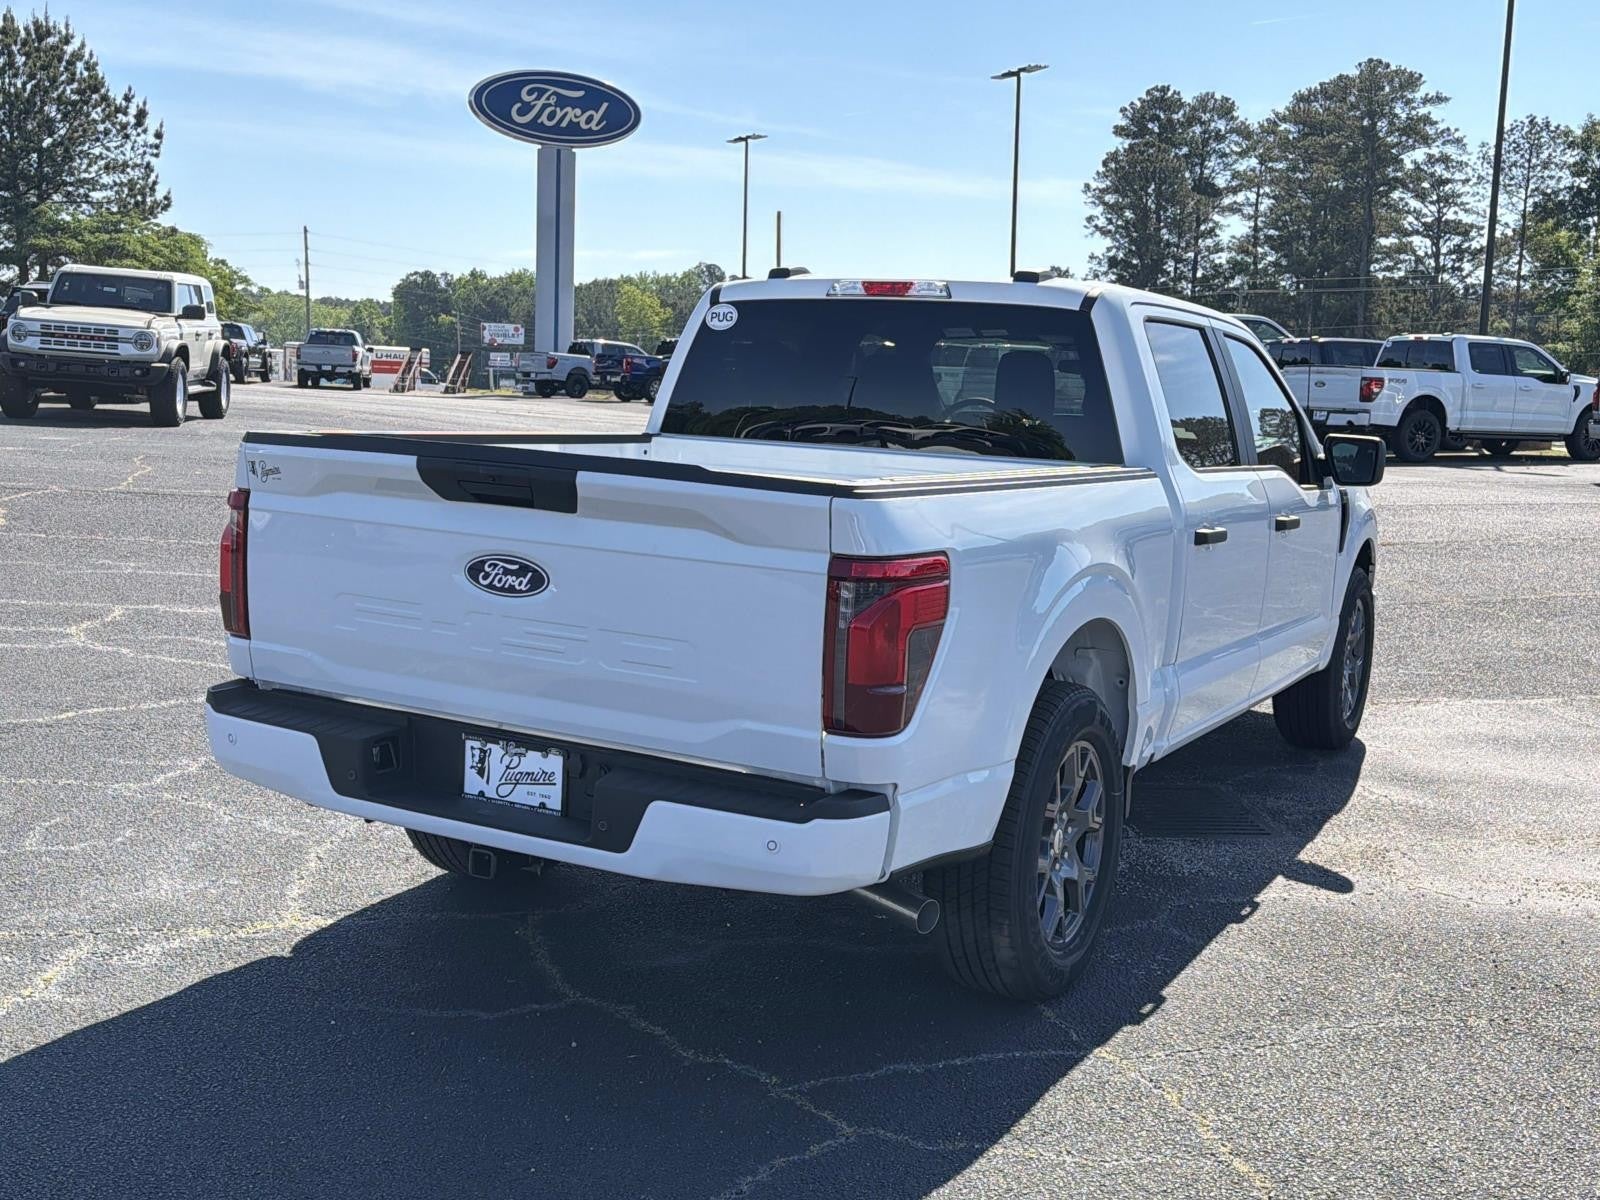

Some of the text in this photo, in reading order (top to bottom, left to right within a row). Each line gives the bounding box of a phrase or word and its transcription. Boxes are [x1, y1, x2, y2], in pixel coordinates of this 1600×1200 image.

[510, 83, 609, 131] Ford
[710, 311, 734, 323] PUG
[375, 352, 405, 360] U-HAU
[478, 560, 533, 591] Ford
[495, 753, 557, 798] Pugmire
